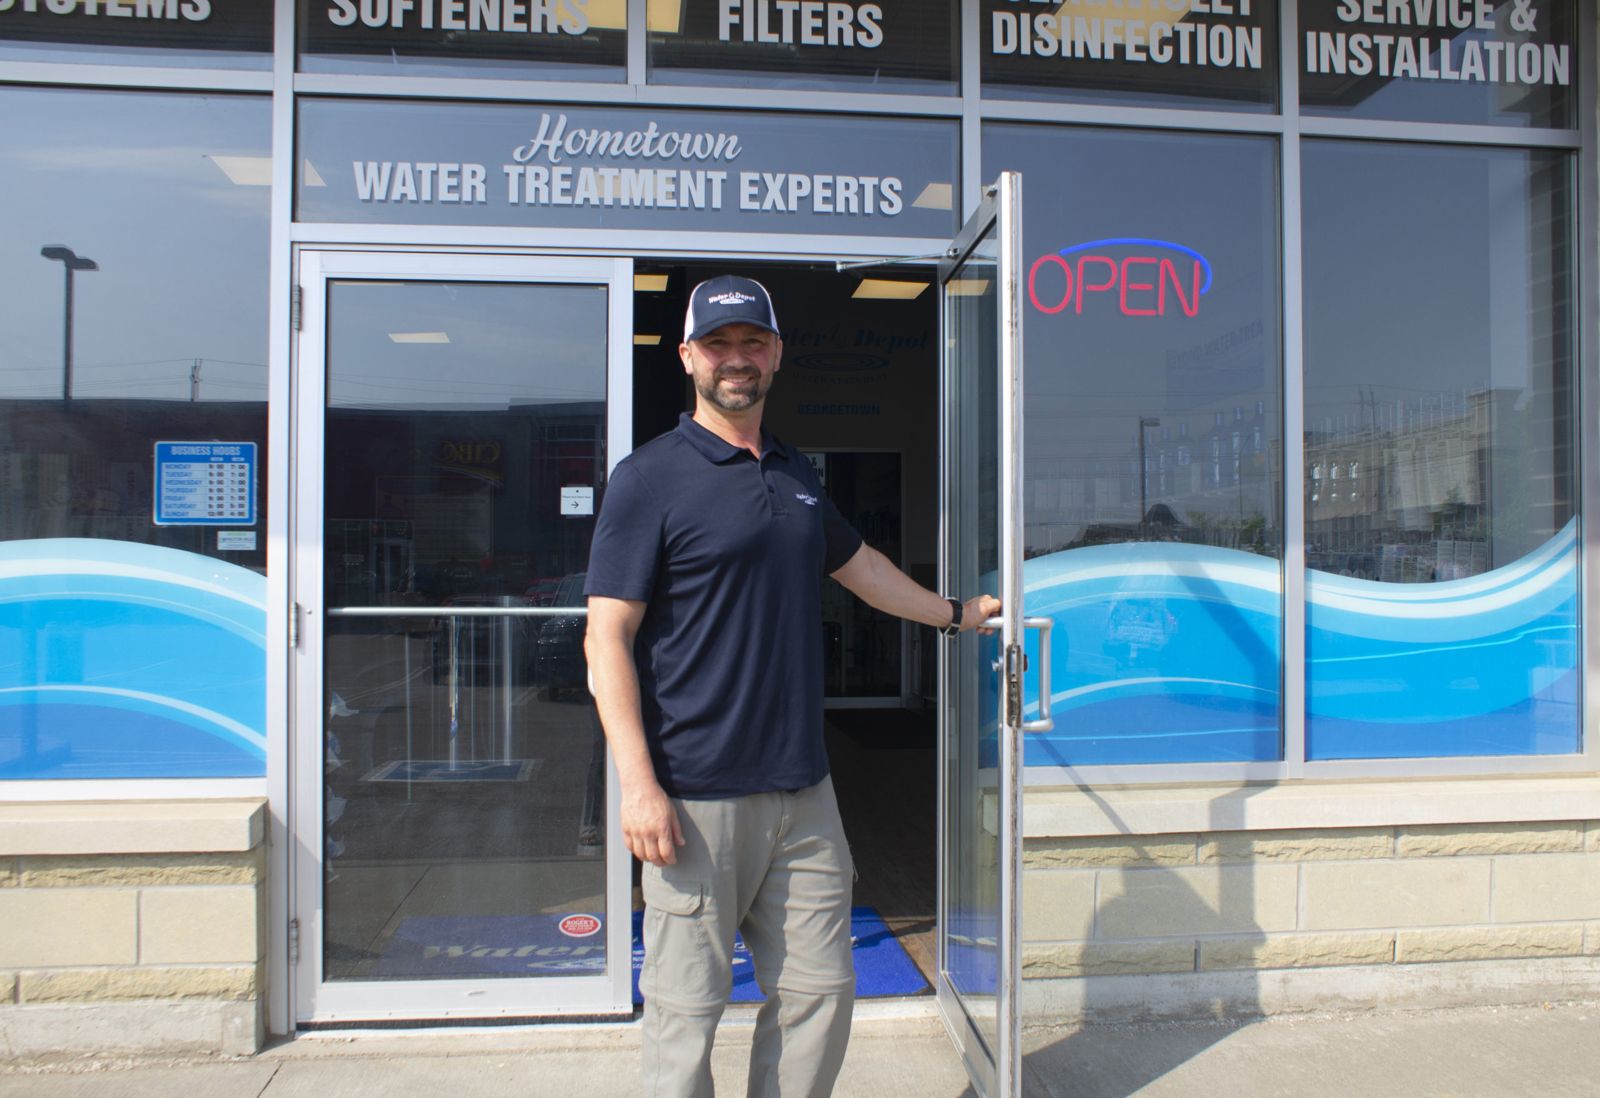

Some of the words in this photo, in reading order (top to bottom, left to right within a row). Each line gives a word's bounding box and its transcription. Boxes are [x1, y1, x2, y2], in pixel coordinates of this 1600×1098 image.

[328, 0, 589, 36] SOFTENERS
[718, 0, 884, 48] FILTERS
[992, 10, 1262, 69] DISINFECTION
[1306, 31, 1570, 86] INSTALLATION
[513, 112, 742, 164] Hometown
[353, 161, 487, 203] WATER
[503, 164, 728, 210] TREATMENT
[739, 171, 903, 216] EXPERTS
[735, 291, 756, 302] Depot
[1028, 254, 1200, 317] OPEN
[855, 328, 929, 354] Depot
[171, 446, 211, 455] BUSINESS
[212, 446, 241, 455] HOURS
